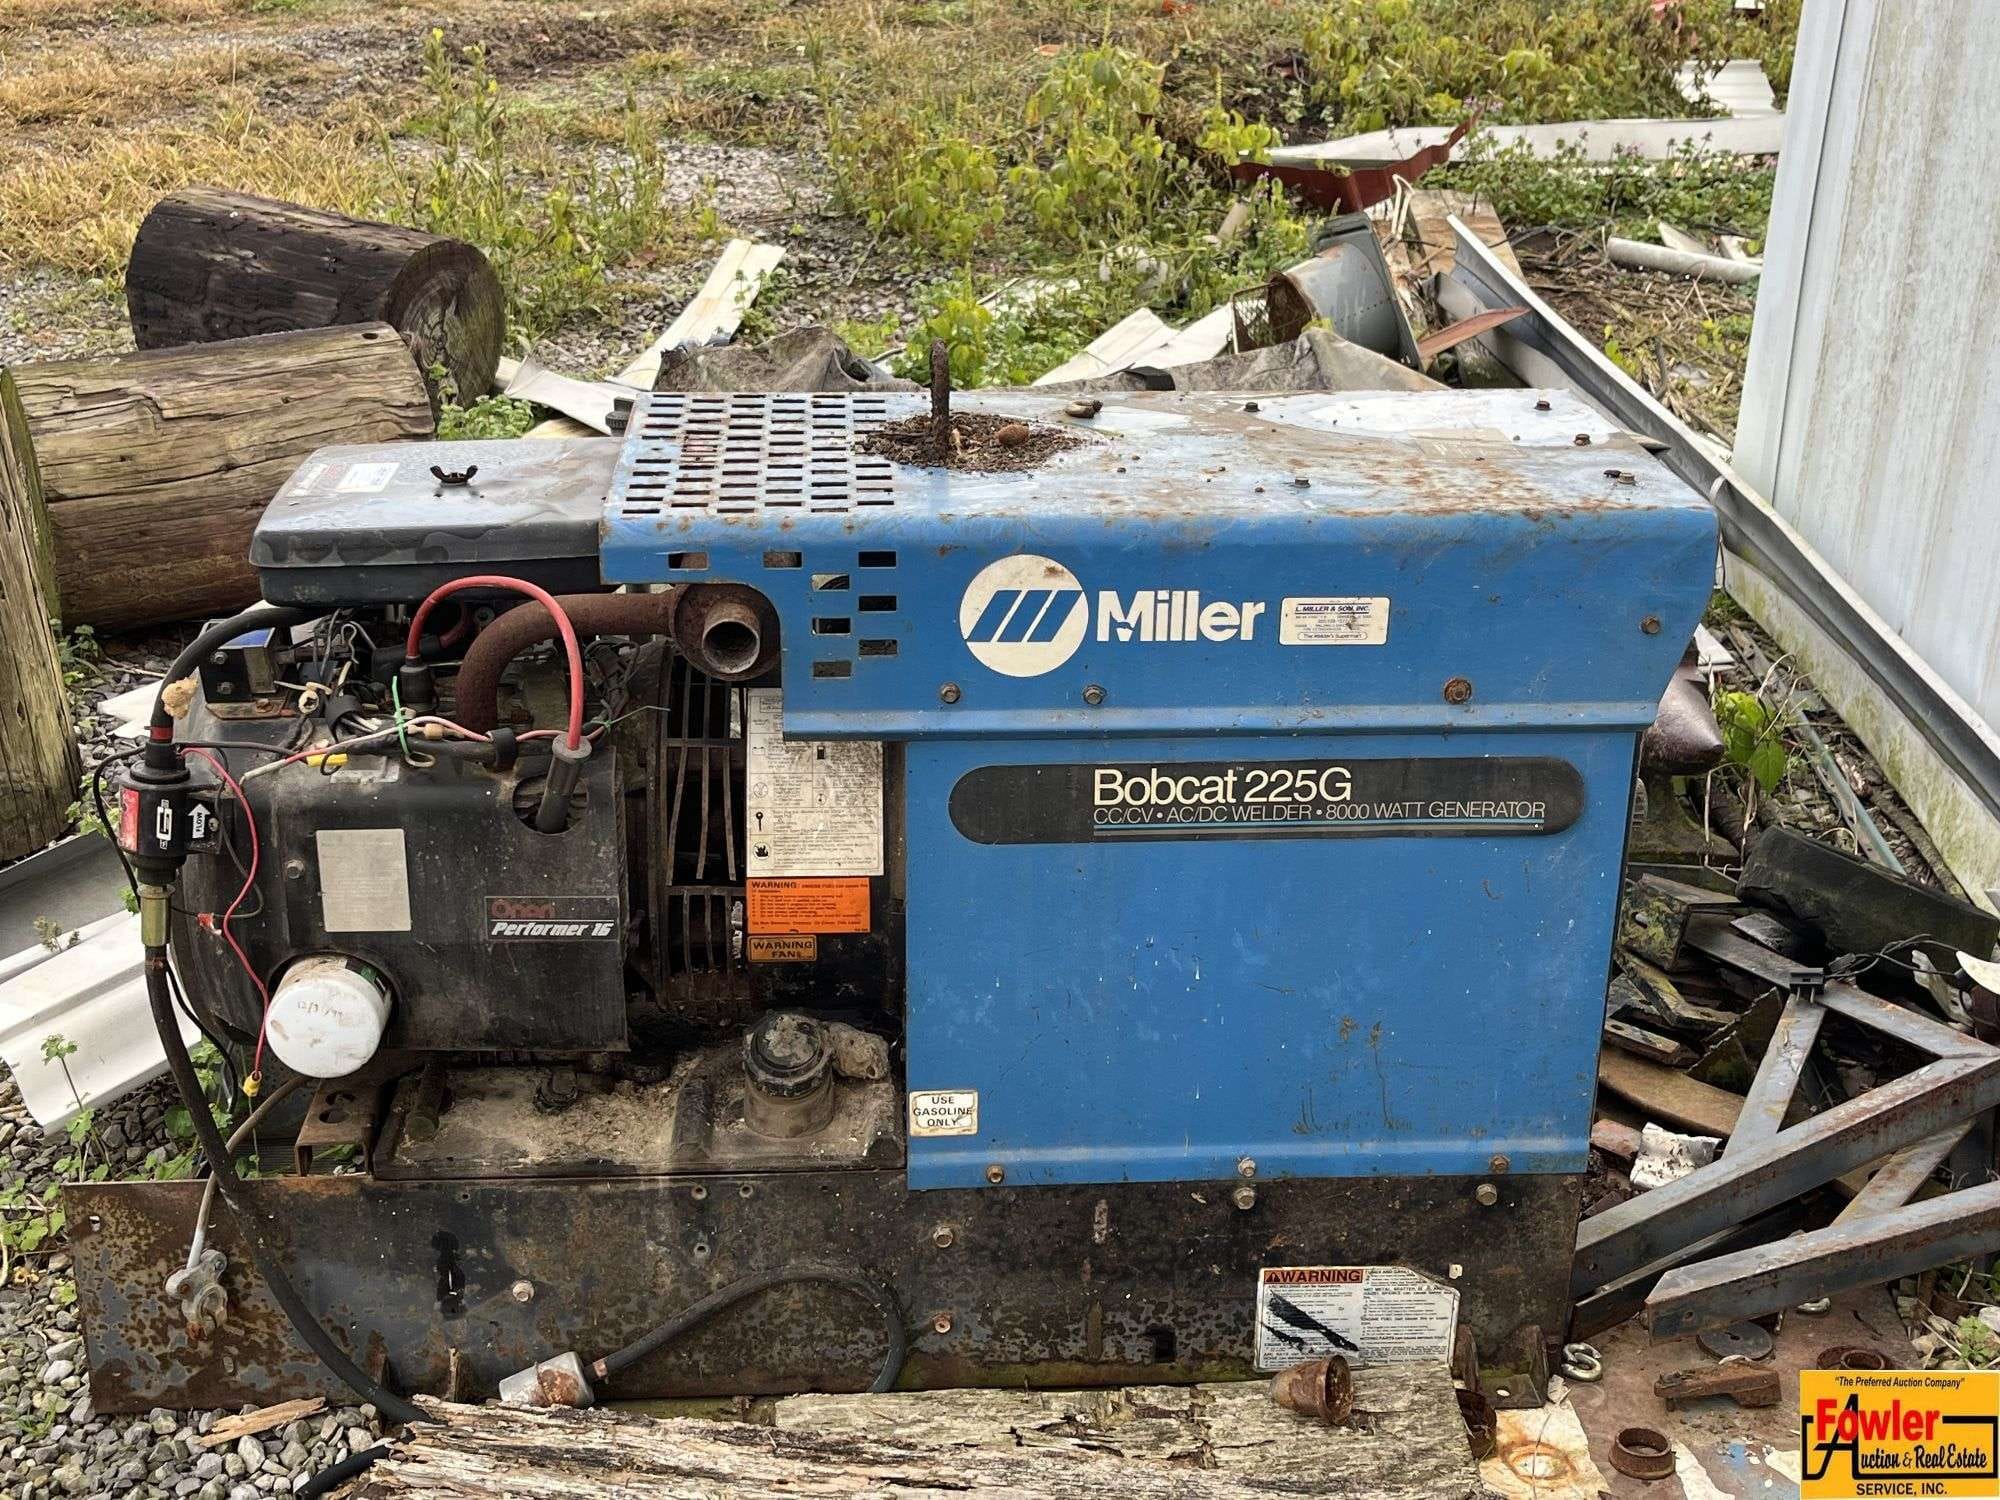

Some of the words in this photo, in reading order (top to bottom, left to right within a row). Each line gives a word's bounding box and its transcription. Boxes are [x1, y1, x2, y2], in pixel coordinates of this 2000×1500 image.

[1097, 590, 1265, 642] Miller
[1243, 767, 1352, 803] 225G
[1093, 807, 1155, 824] CC/CV
[1167, 806, 1228, 823] AC/DC
[1232, 804, 1312, 822] WELDER
[1326, 803, 1369, 820] 8000
[1374, 802, 1425, 819] WATT
[1428, 801, 1546, 819] GENERATOR
[195, 812, 203, 833] FLOW
[491, 922, 589, 937] Performer
[753, 941, 813, 950] WARNING
[931, 1096, 955, 1104] USE
[913, 1107, 973, 1116] GASOLINE
[927, 1118, 958, 1127] ONLY
[1281, 1270, 1361, 1283] WARNING
